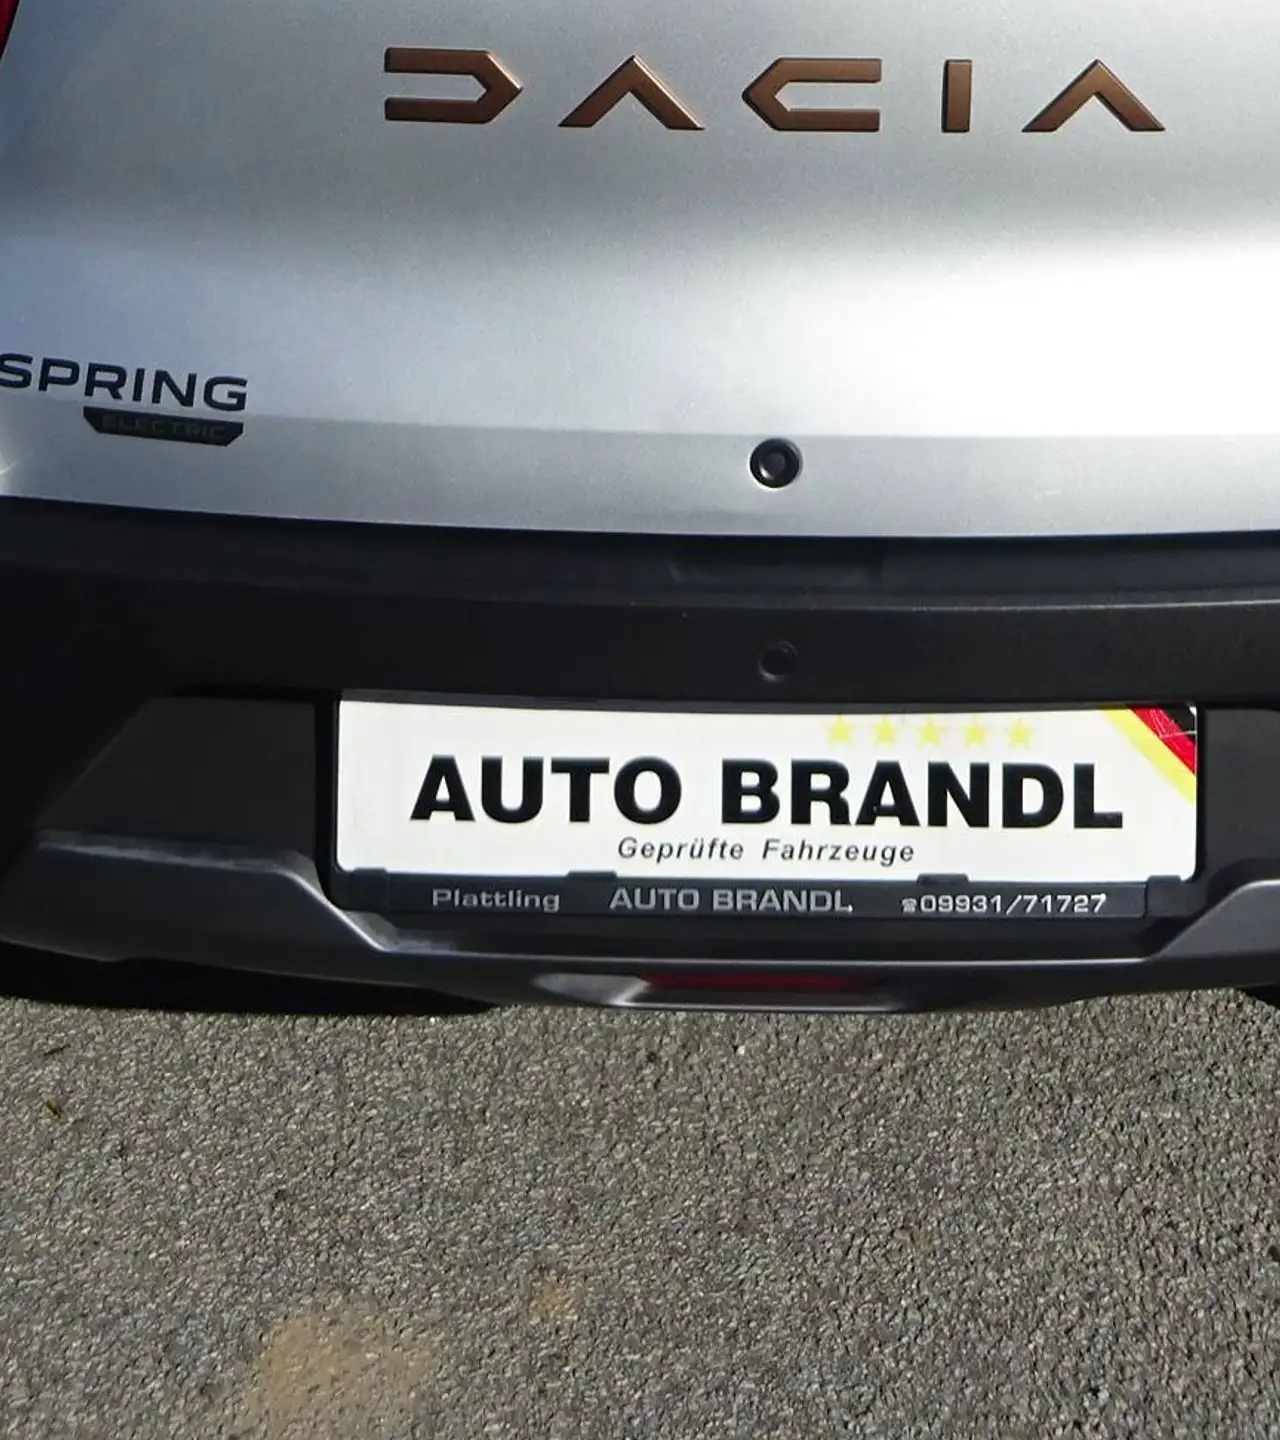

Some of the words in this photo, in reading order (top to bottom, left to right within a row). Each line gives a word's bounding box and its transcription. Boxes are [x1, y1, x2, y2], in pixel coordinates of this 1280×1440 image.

[384, 47, 1166, 132] DACIA
[101, 415, 227, 440] ELECTRIC
[410, 754, 682, 825] AUTO
[721, 758, 1124, 829] BRANDL
[617, 837, 744, 864] Geprüfte
[762, 838, 915, 867] Fahrzeuge
[432, 888, 560, 912] Plattling
[608, 887, 700, 911] AUTO
[713, 889, 852, 914] BRANDL
